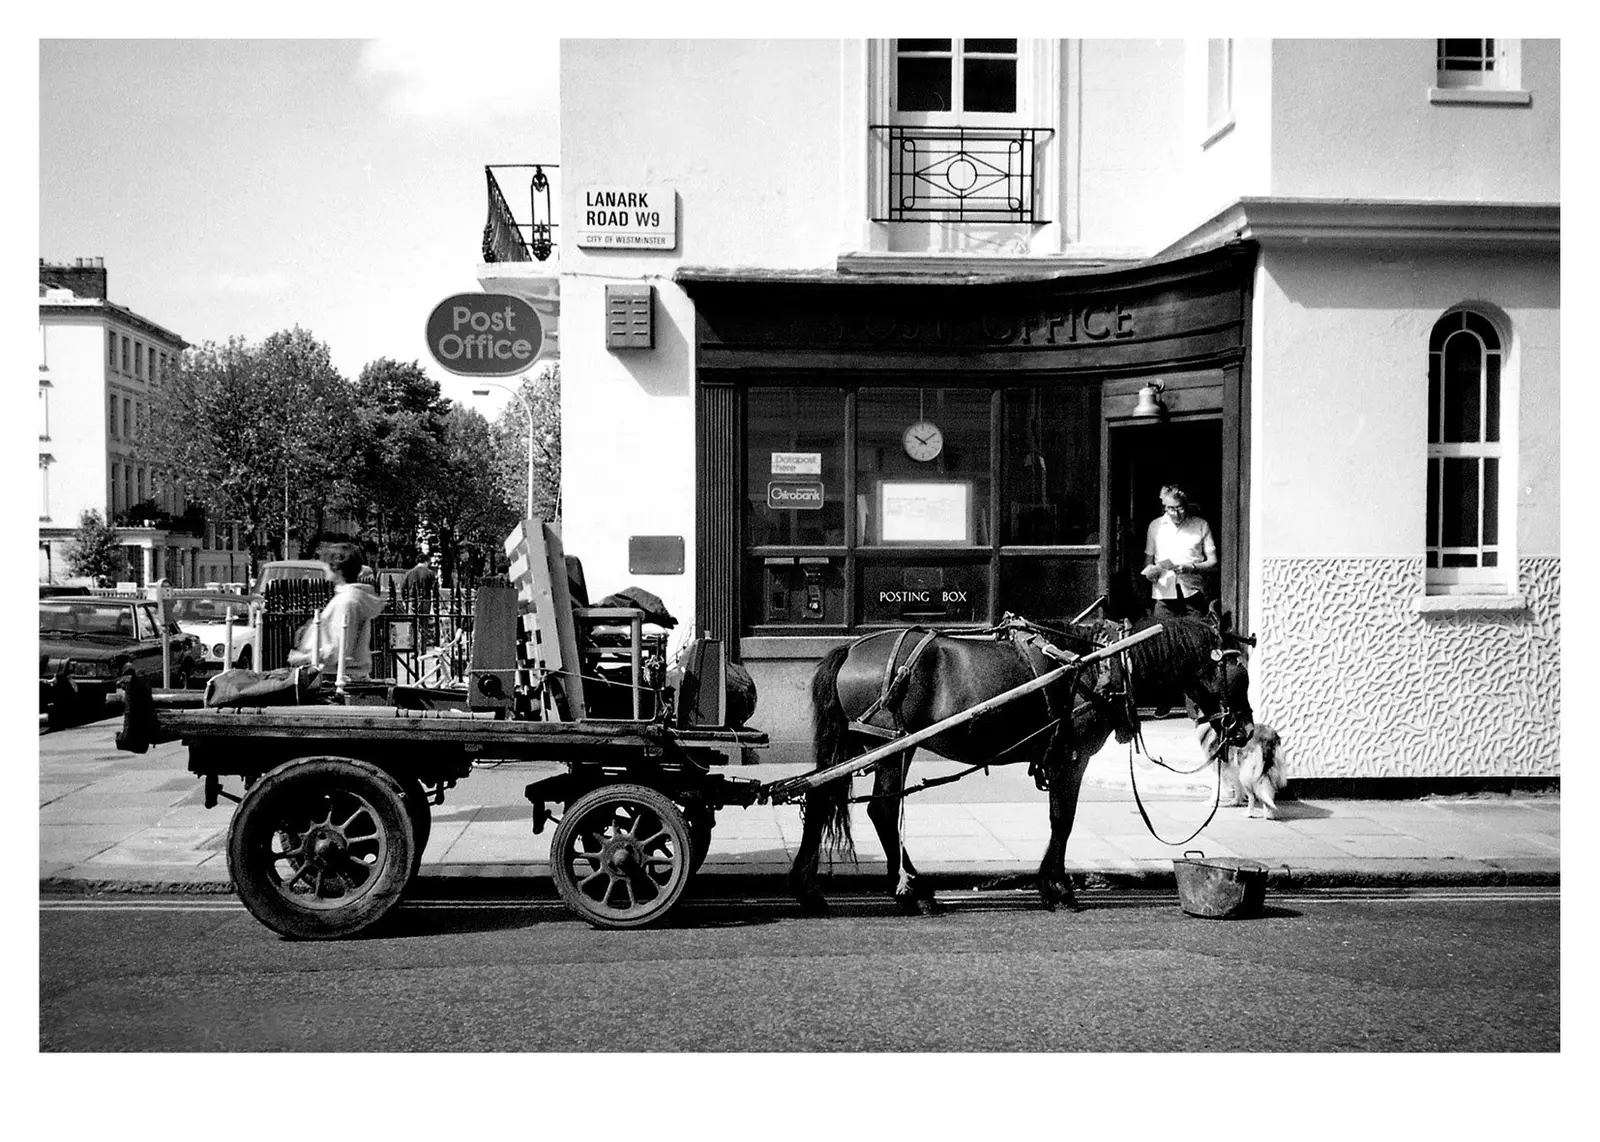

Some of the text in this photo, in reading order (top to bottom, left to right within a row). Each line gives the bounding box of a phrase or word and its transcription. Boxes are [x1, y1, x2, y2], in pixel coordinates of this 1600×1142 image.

[586, 191, 648, 208] LANARK
[586, 210, 660, 227] ROAD W9
[586, 235, 602, 243] CITY
[616, 236, 666, 245] WESTMINSTER
[453, 305, 516, 332] Post
[982, 302, 1135, 344] OFFICE
[439, 334, 532, 360] Office
[775, 455, 818, 465] Datapost
[775, 464, 797, 472] here
[771, 487, 820, 500] Girobank
[879, 591, 967, 602] POSTING BOX
